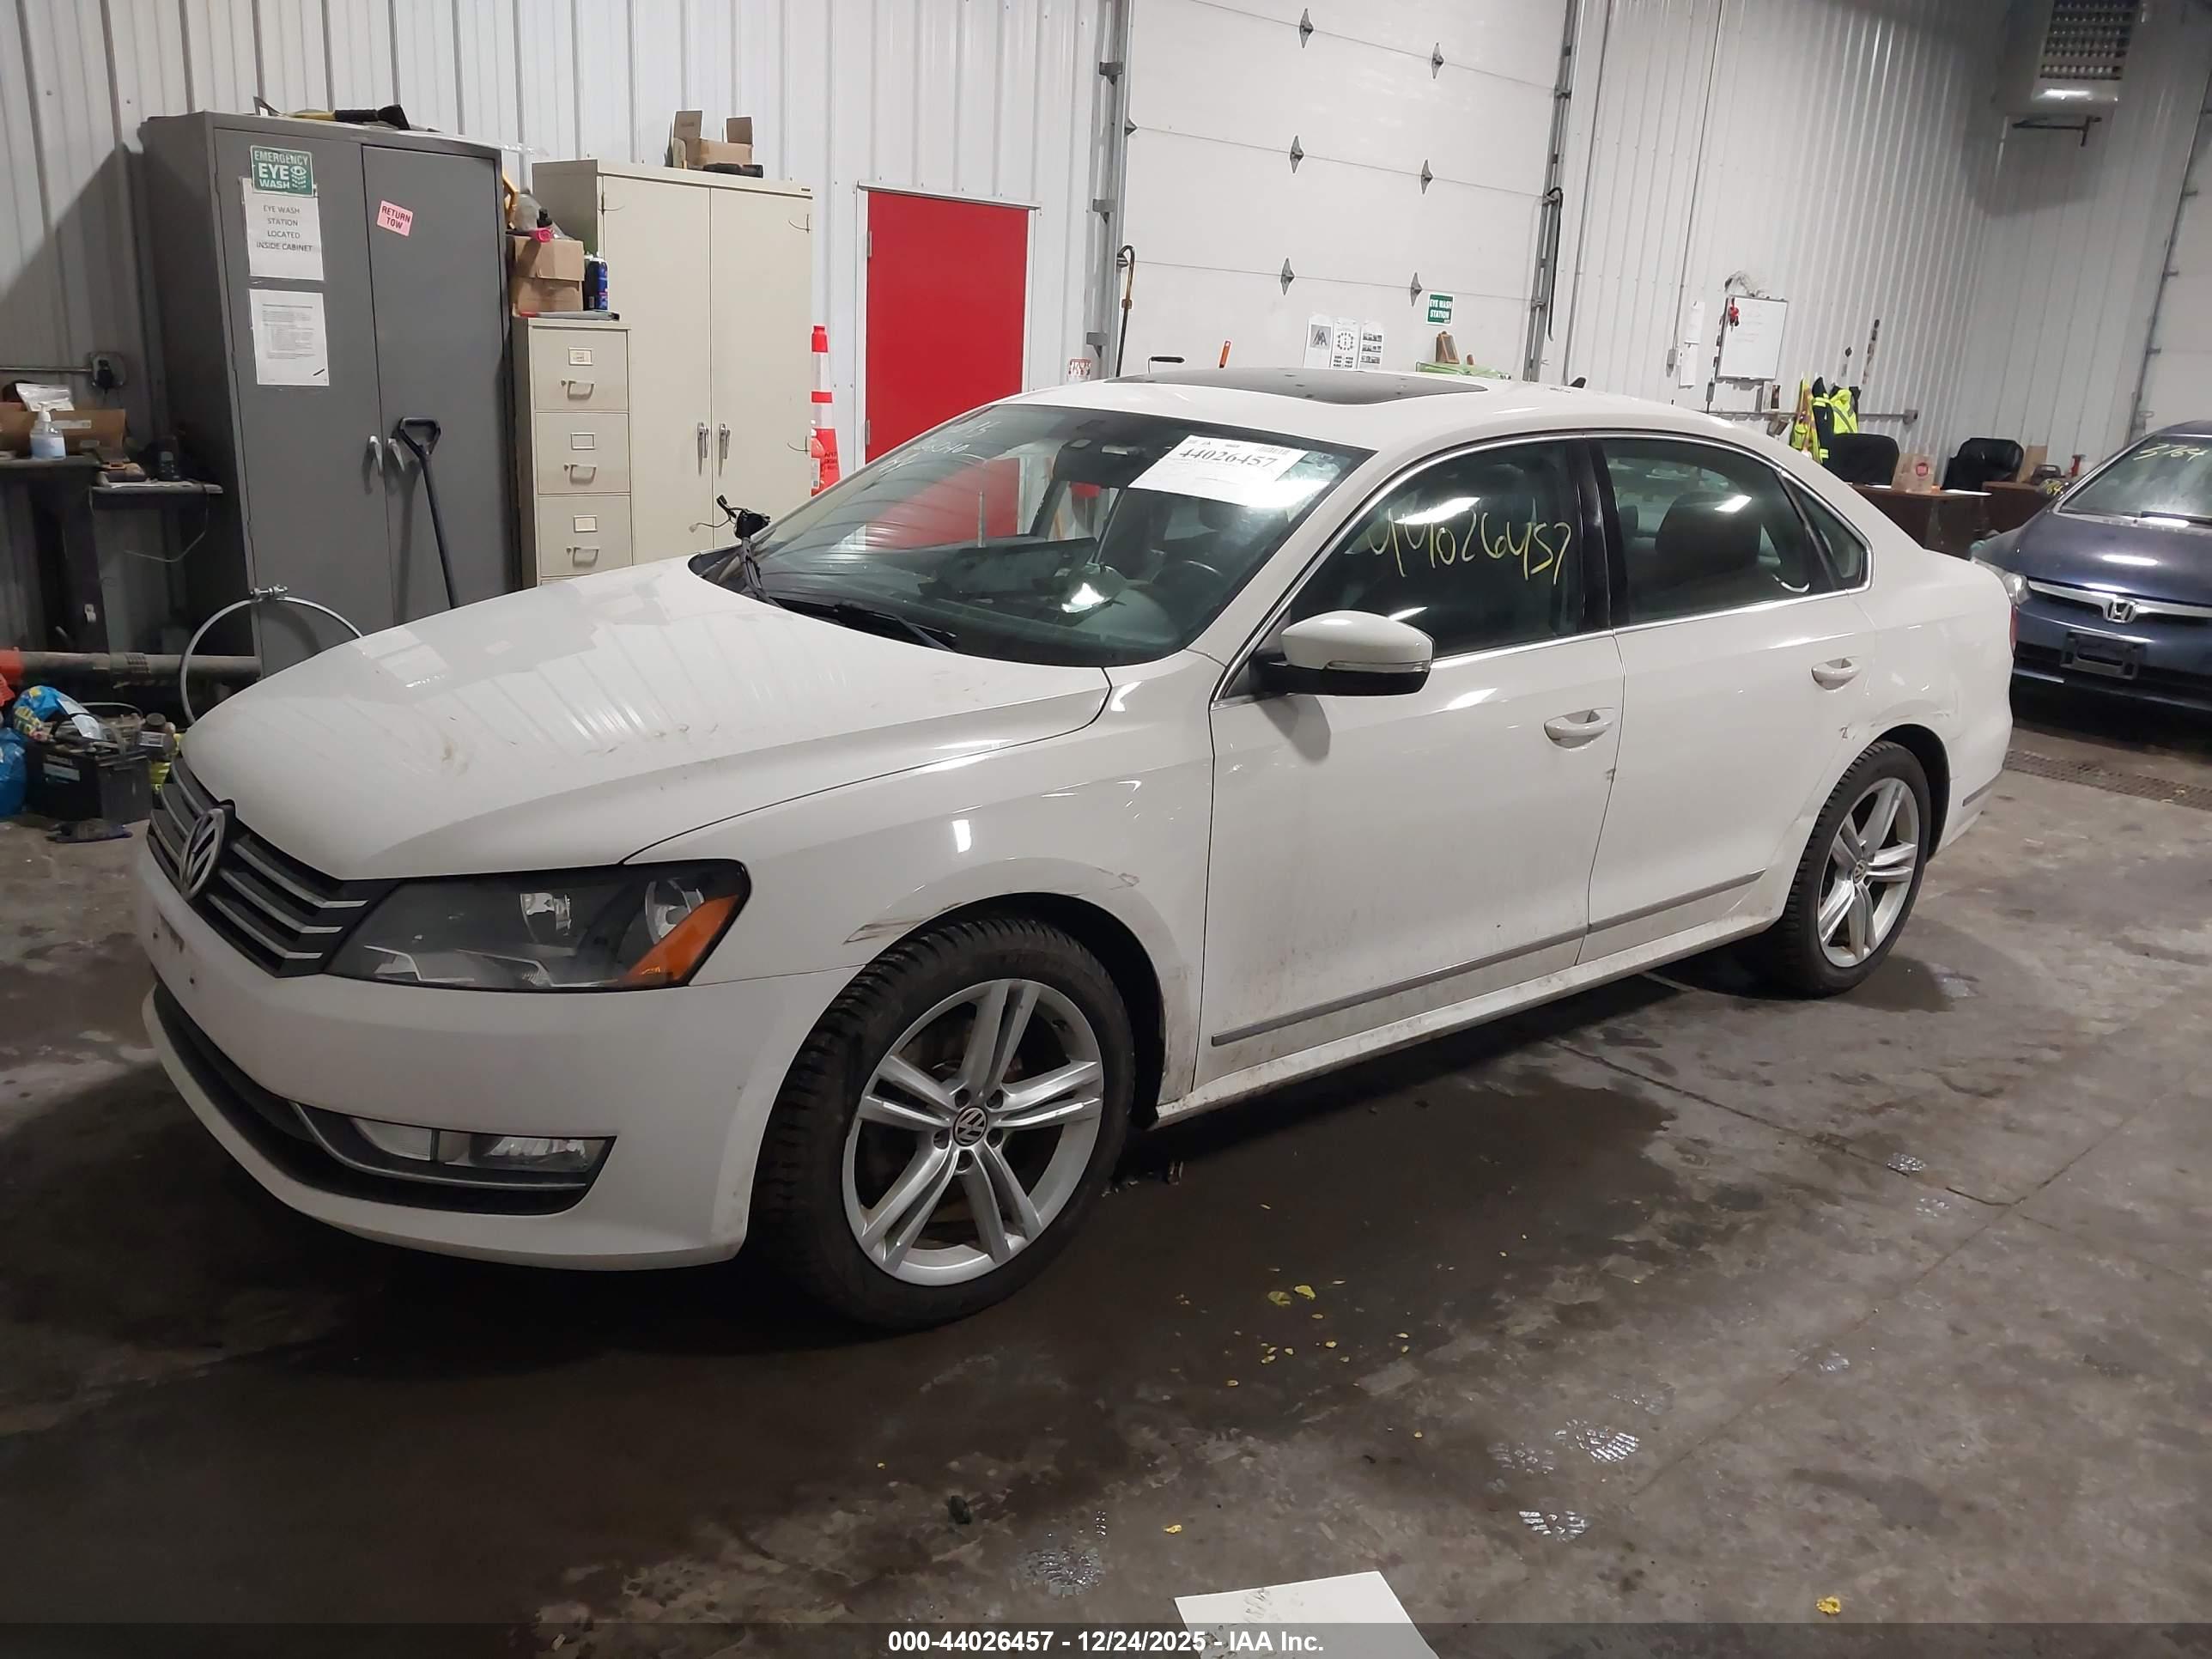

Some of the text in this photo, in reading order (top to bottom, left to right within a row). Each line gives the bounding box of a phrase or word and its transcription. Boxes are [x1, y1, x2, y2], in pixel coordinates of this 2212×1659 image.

[254, 150, 308, 165] EMERGENCY
[258, 162, 289, 180] EYE
[259, 179, 290, 189] WASH
[263, 204, 301, 215] EYE WASH
[382, 205, 410, 223] RETURN
[267, 217, 298, 227] STATION
[386, 216, 404, 229] TOW
[267, 230, 301, 239] LOCATED
[256, 241, 313, 252] INSIDE CABINET
[1429, 299, 1439, 308] EYE
[1429, 309, 1450, 319] STATION
[1179, 447, 1279, 468] 44026457
